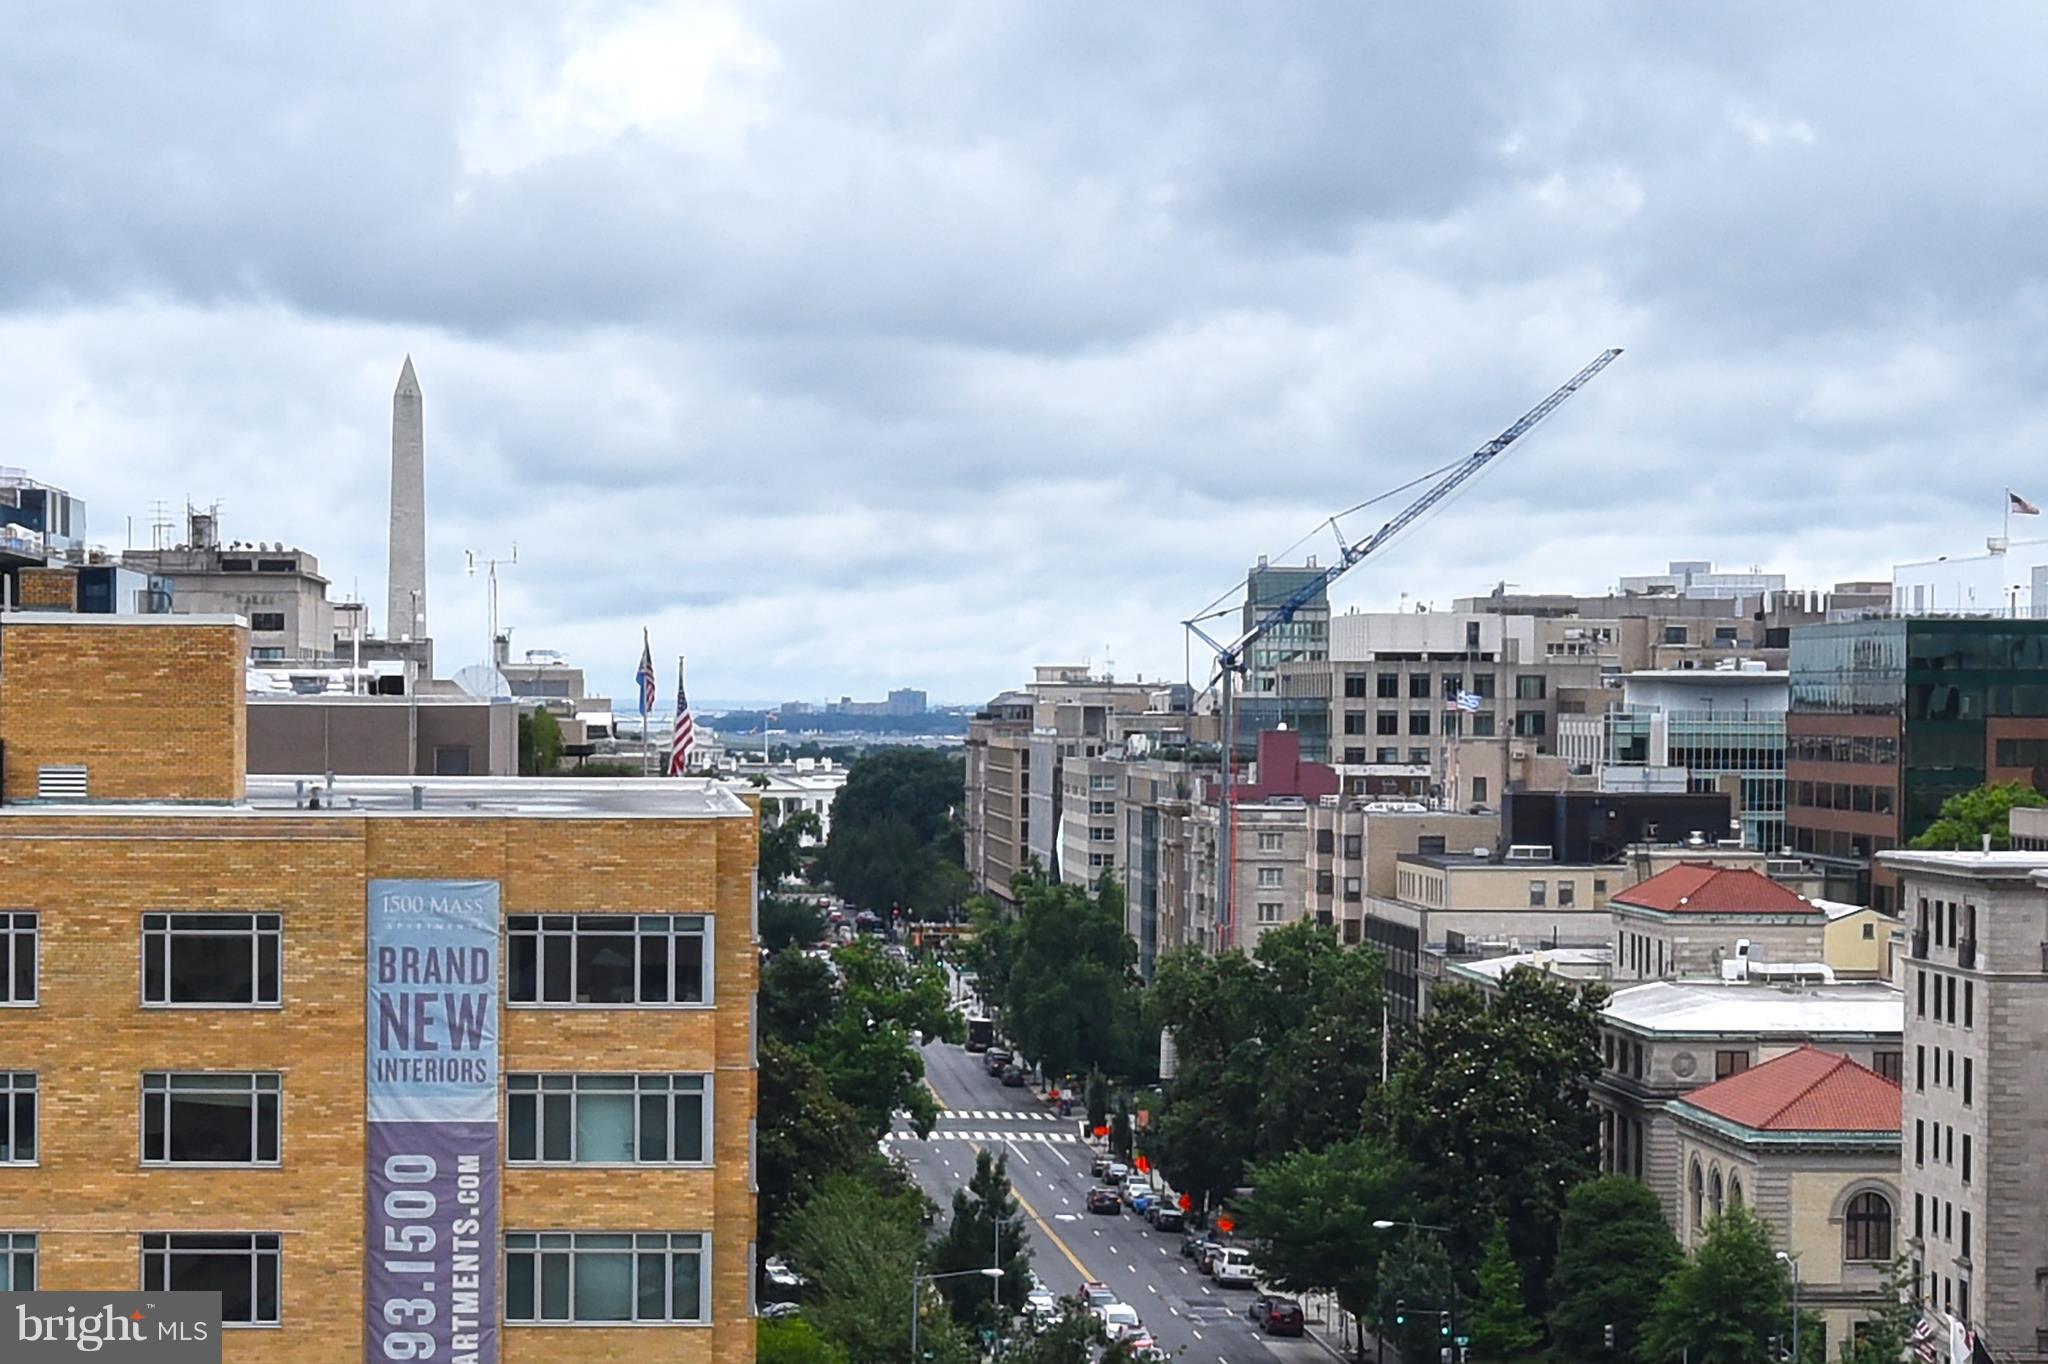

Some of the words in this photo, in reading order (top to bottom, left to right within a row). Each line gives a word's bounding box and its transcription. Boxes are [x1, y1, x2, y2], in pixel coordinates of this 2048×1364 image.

[383, 896, 424, 913] 1500
[430, 896, 484, 914] MASS
[378, 946, 490, 985] BRAND
[379, 992, 488, 1051] NEW
[377, 1058, 487, 1083] INTERIORS
[383, 1155, 437, 1360] 93.1500
